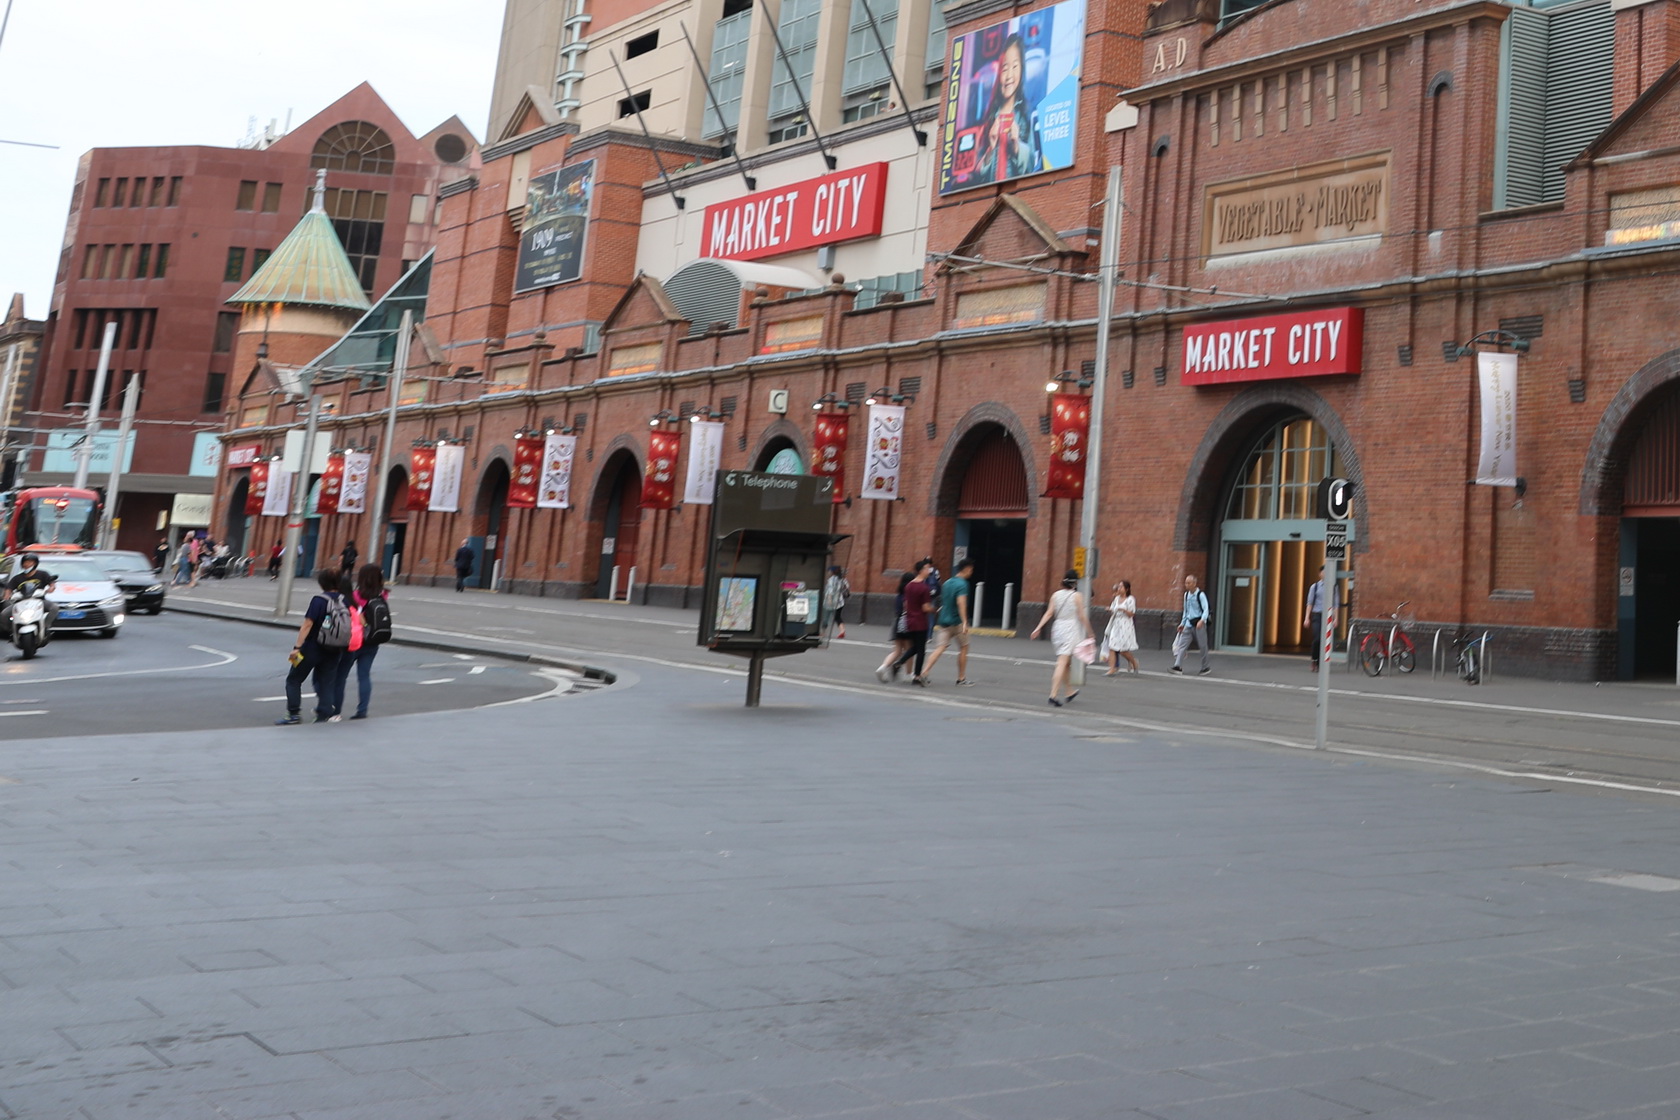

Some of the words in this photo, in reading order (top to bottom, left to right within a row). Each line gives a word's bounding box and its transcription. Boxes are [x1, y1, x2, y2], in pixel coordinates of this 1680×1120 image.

[940, 40, 964, 191] TIMEZONE
[1043, 125, 1070, 143] THREE
[1044, 110, 1070, 127] LEVEL
[709, 190, 799, 258] MARKET
[812, 173, 867, 237] CITY
[1218, 192, 1304, 244] VEGETABLE
[1314, 179, 1382, 231] MARKET
[1185, 326, 1275, 375] MARKET
[1287, 319, 1343, 365] CITY
[773, 392, 785, 411] C
[741, 473, 798, 491] Telephone
